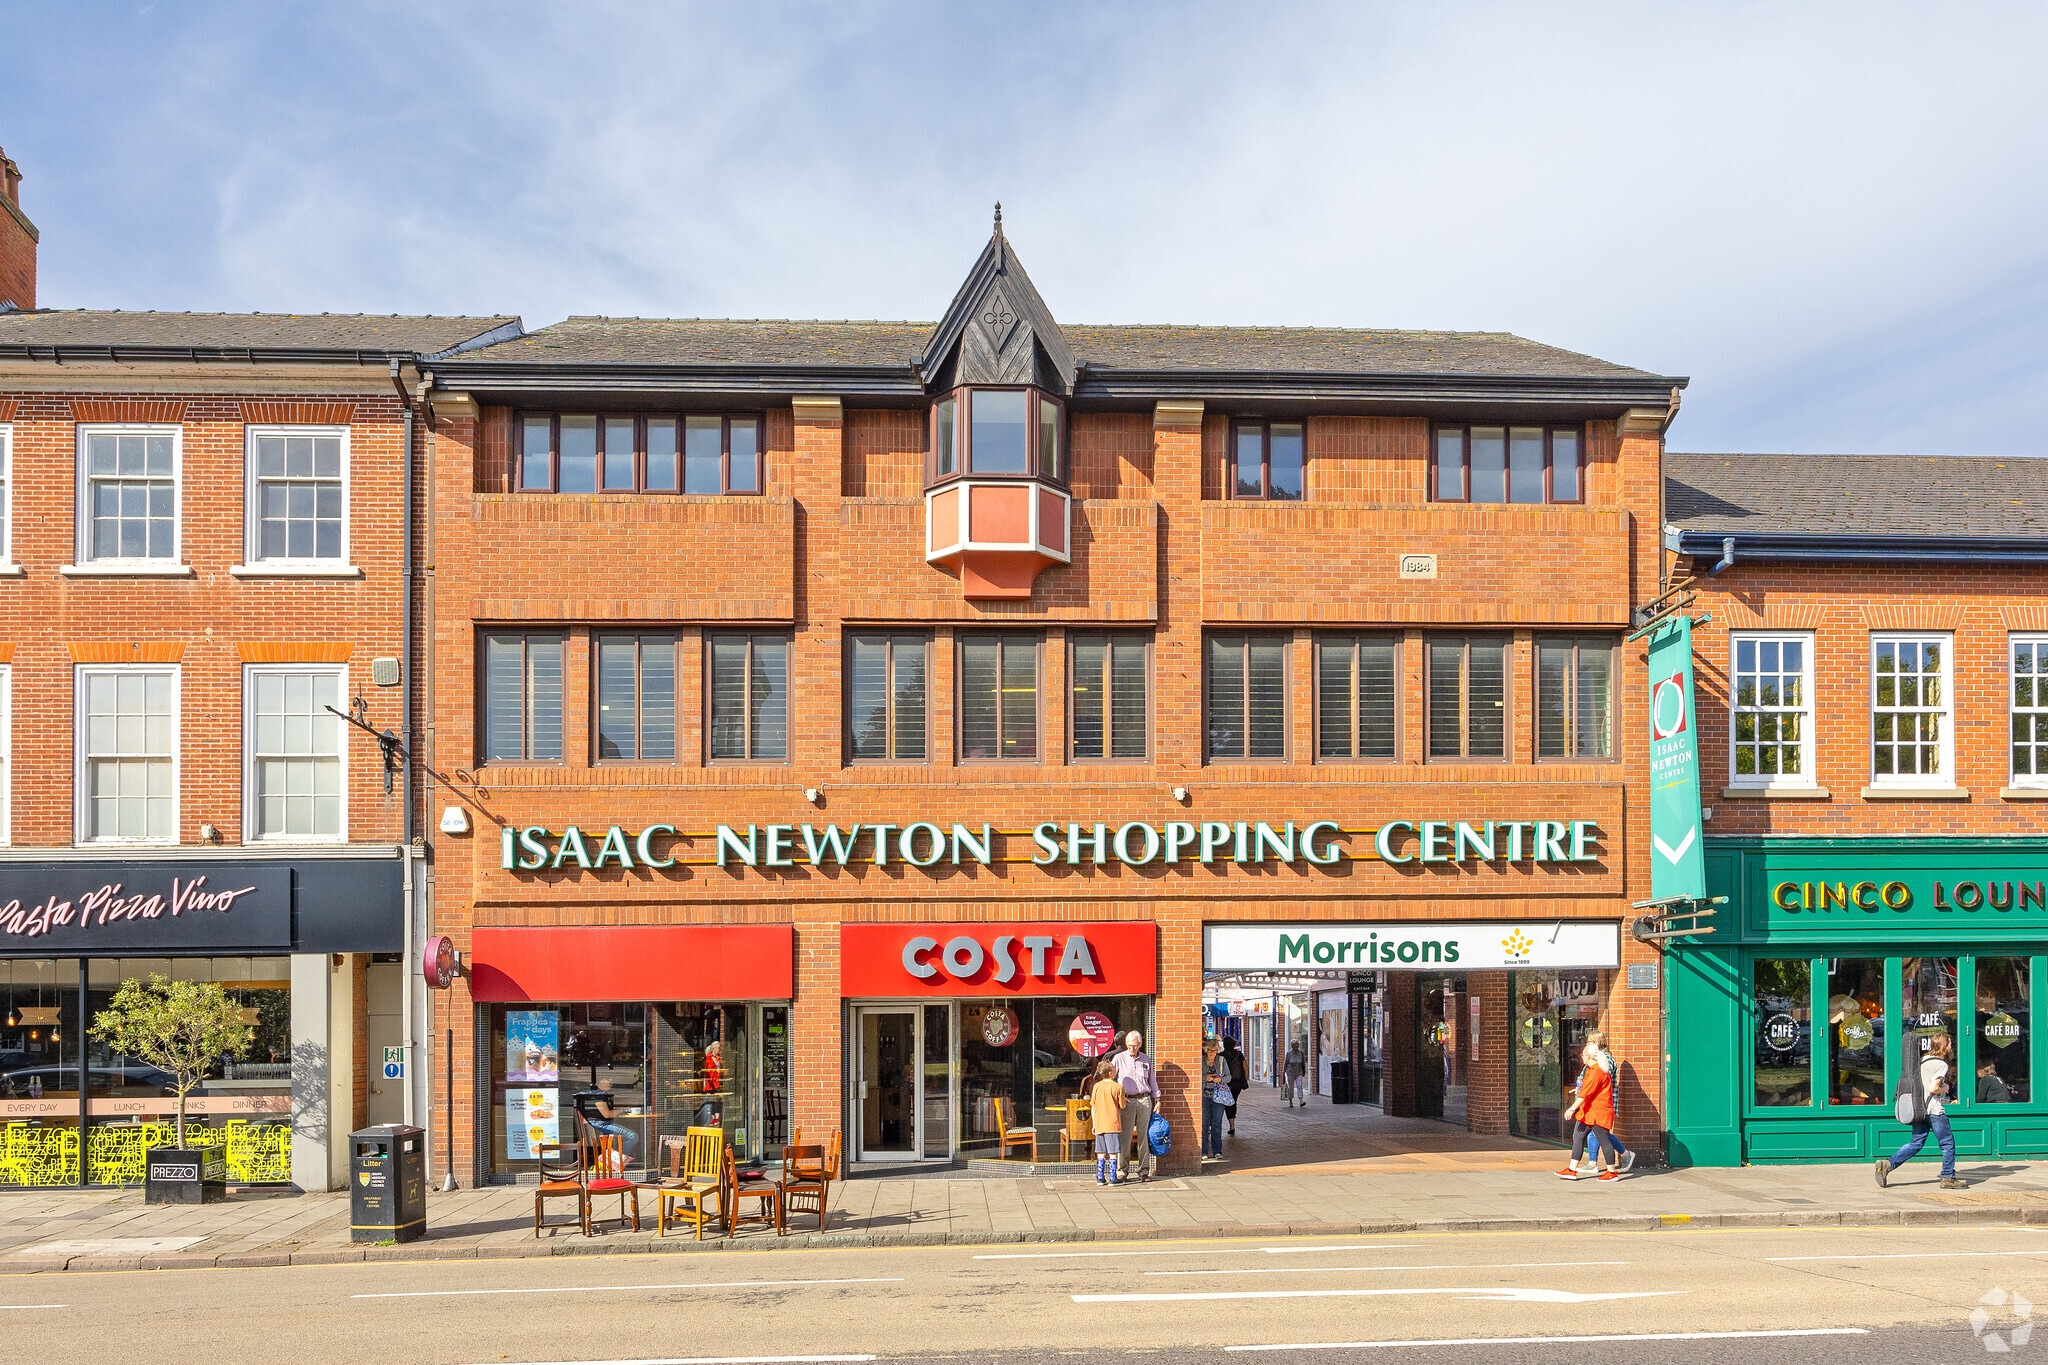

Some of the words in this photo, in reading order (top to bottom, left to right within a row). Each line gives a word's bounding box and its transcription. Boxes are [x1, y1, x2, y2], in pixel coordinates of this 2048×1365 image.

[1406, 562, 1431, 573] 1984
[1656, 738, 1685, 757] ISAAC
[1651, 750, 1692, 773] NEWTON
[1659, 766, 1685, 780] CENTRE
[501, 824, 676, 871] ISAAC
[716, 822, 992, 867] NEWTON
[1031, 820, 1341, 866] SHOPPING
[1375, 819, 1598, 864] CENTRE
[79, 883, 166, 928] Pizza
[172, 875, 256, 916] Vino
[1772, 880, 1911, 910] CINCO
[1278, 931, 1460, 964] Morrisons
[902, 935, 1098, 984] COSTA
[986, 1010, 1005, 1021] COSTA
[1920, 1010, 1940, 1026] CAFÉ
[531, 1026, 552, 1034] days
[985, 1029, 1008, 1043] COFFEE
[1771, 1021, 1793, 1038] CAFÉ
[1985, 1022, 2003, 1036] CAFÉ
[2004, 1025, 2020, 1036] BAR
[1921, 1038, 1932, 1051] BA
[7, 1104, 37, 1112] EVERY
[40, 1103, 58, 1111] DAY
[114, 1103, 146, 1111] LUNCH
[172, 1101, 206, 1110] DNKS
[232, 1100, 267, 1109] DINNER
[153, 1167, 195, 1178] PREZZO
